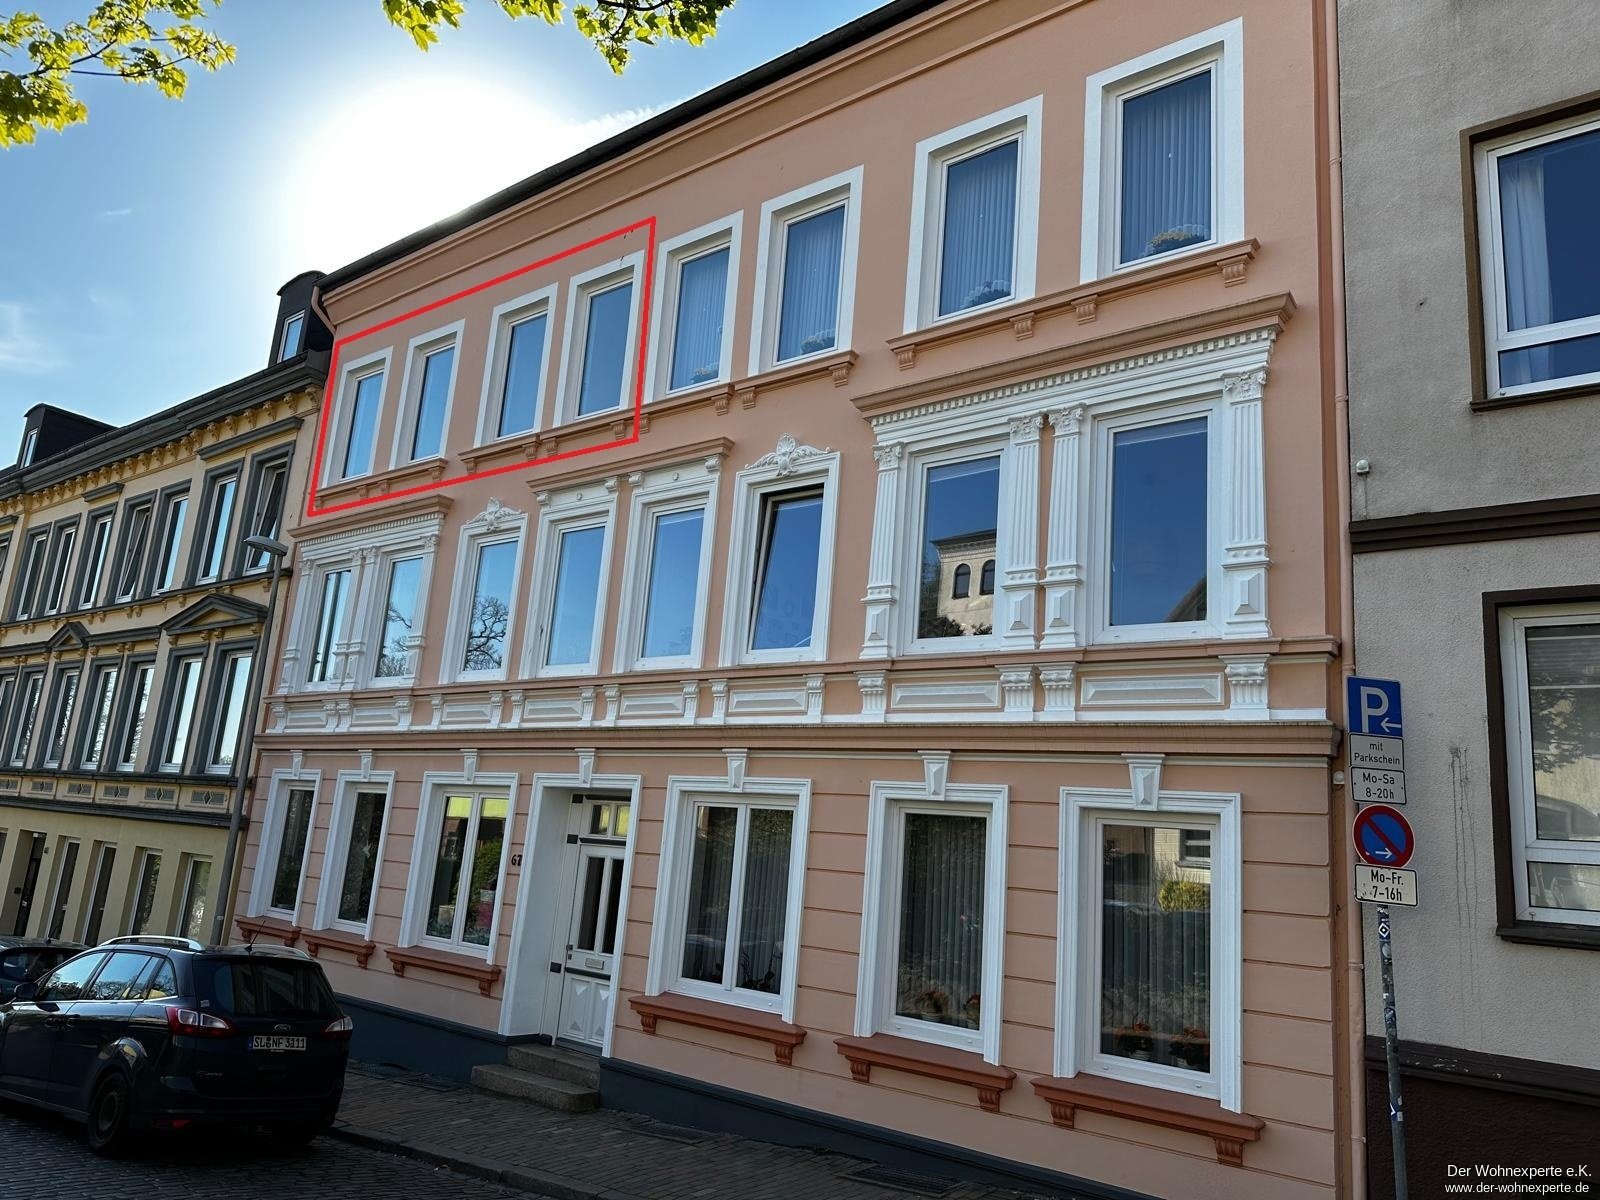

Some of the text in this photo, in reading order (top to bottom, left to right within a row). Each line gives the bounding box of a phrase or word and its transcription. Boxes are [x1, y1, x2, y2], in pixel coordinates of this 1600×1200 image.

[1360, 686, 1389, 733] P
[1369, 742, 1383, 751] mit
[1354, 752, 1400, 765] Parkschein
[1362, 771, 1395, 785] Mo-Sa
[1365, 787, 1394, 799] 8-20h
[1370, 869, 1404, 886] Mo-Fr.
[1372, 886, 1402, 901] 7-16h
